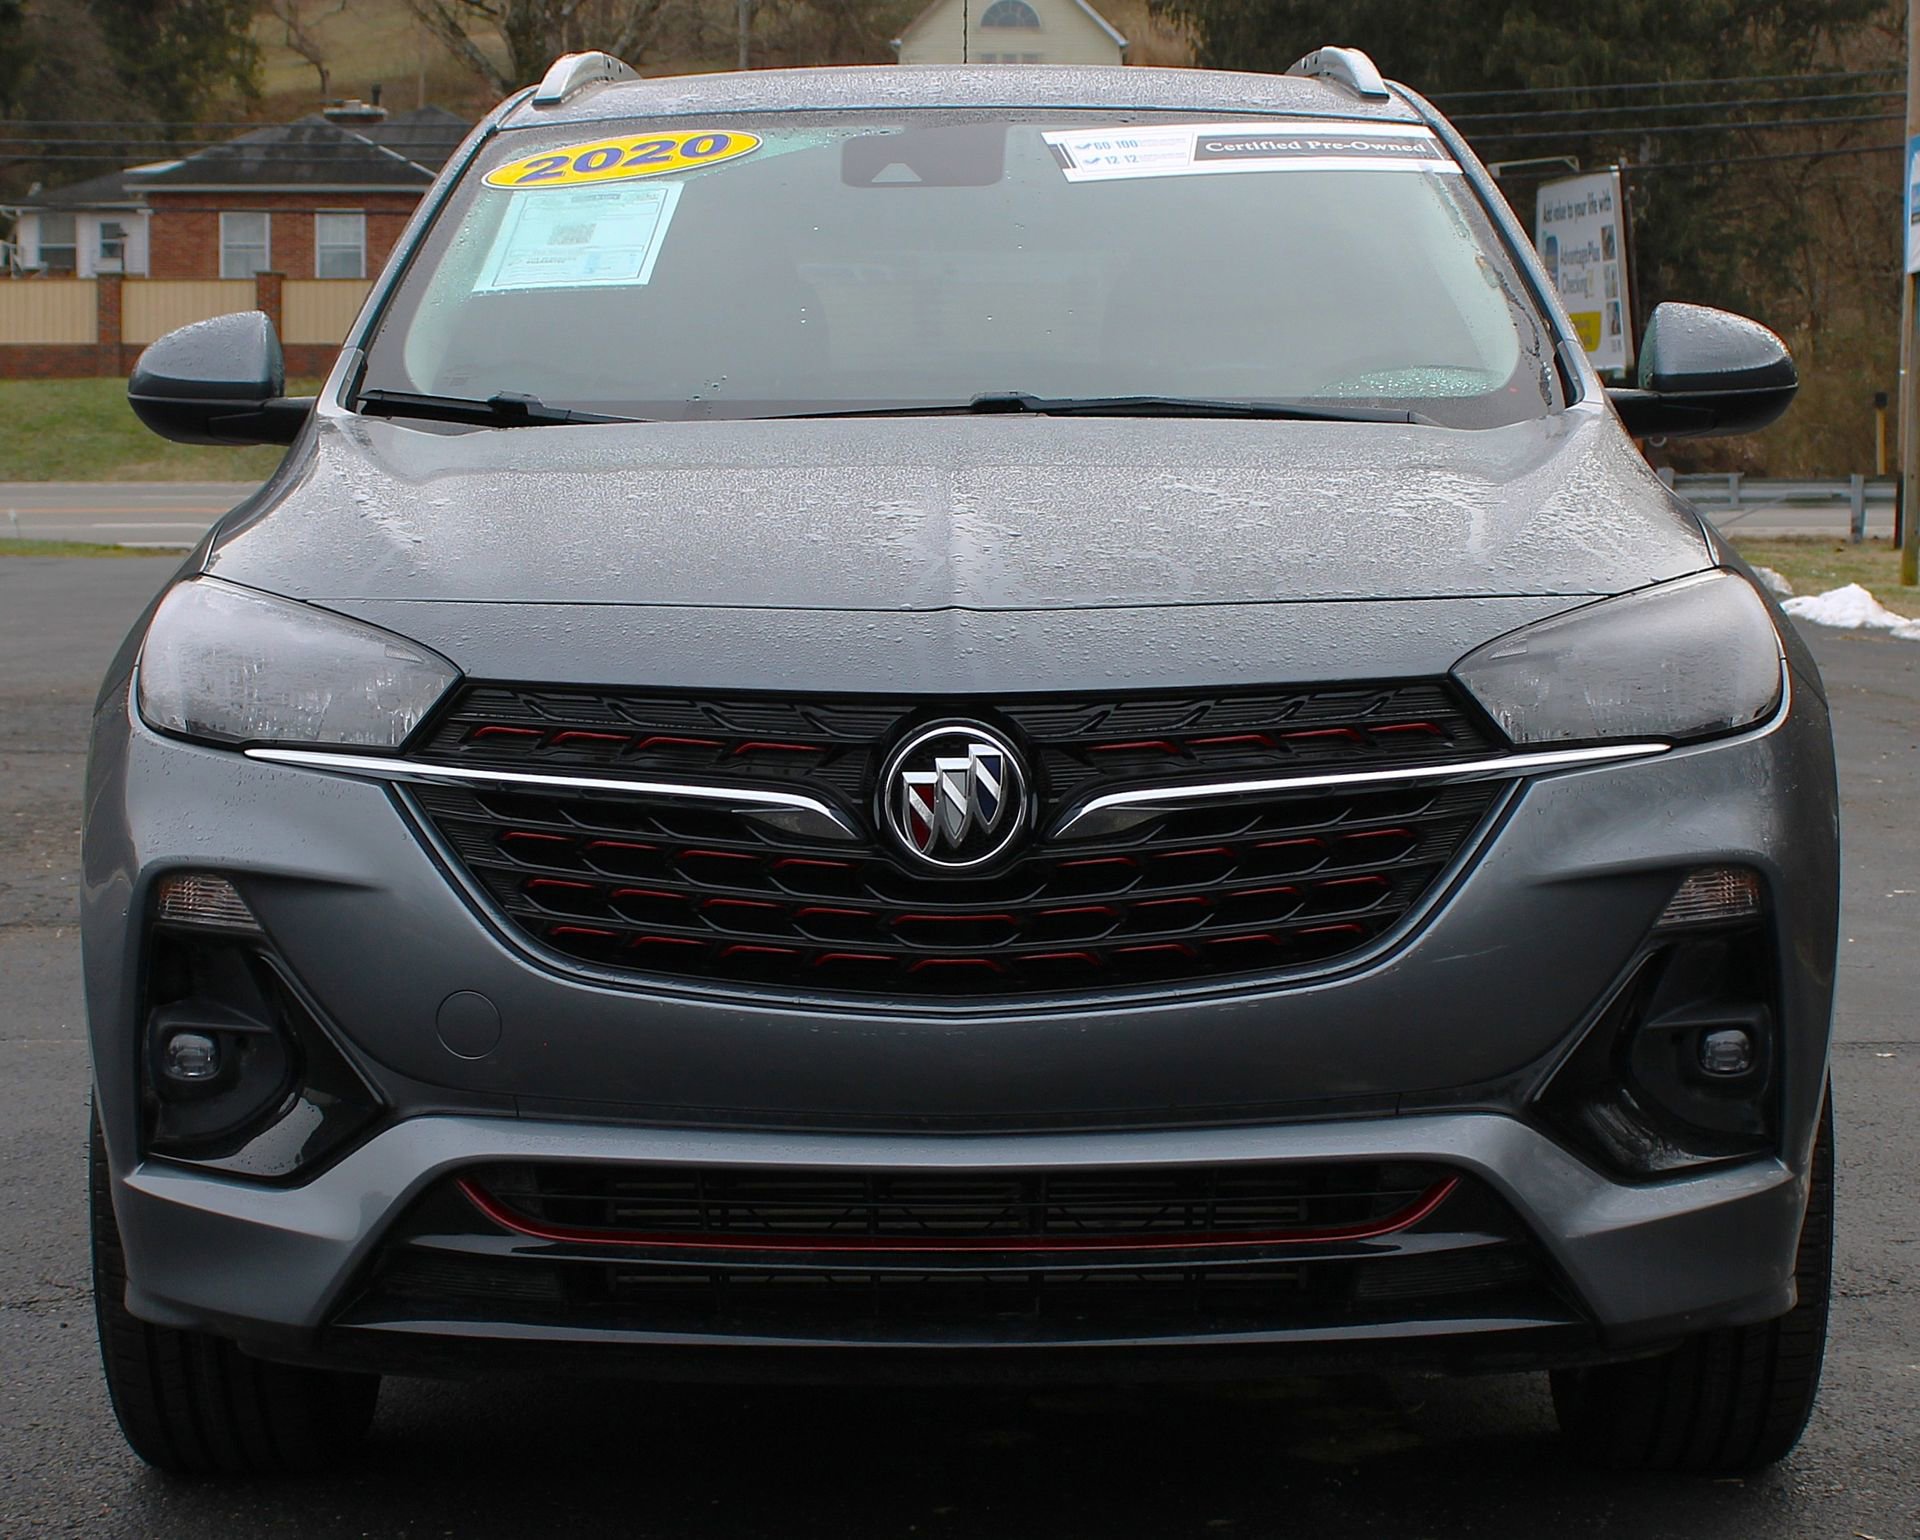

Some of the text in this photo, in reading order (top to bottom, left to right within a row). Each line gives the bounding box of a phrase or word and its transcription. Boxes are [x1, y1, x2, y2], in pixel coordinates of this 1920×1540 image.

[516, 133, 732, 184] 2020
[1104, 156, 1120, 165] 12
[1124, 154, 1140, 163] 12
[1205, 139, 1427, 155] Certified Pre-Owned
[1567, 199, 1573, 219] to
[1574, 201, 1586, 224] your
[1587, 191, 1597, 215] life
[1598, 188, 1611, 212] with
